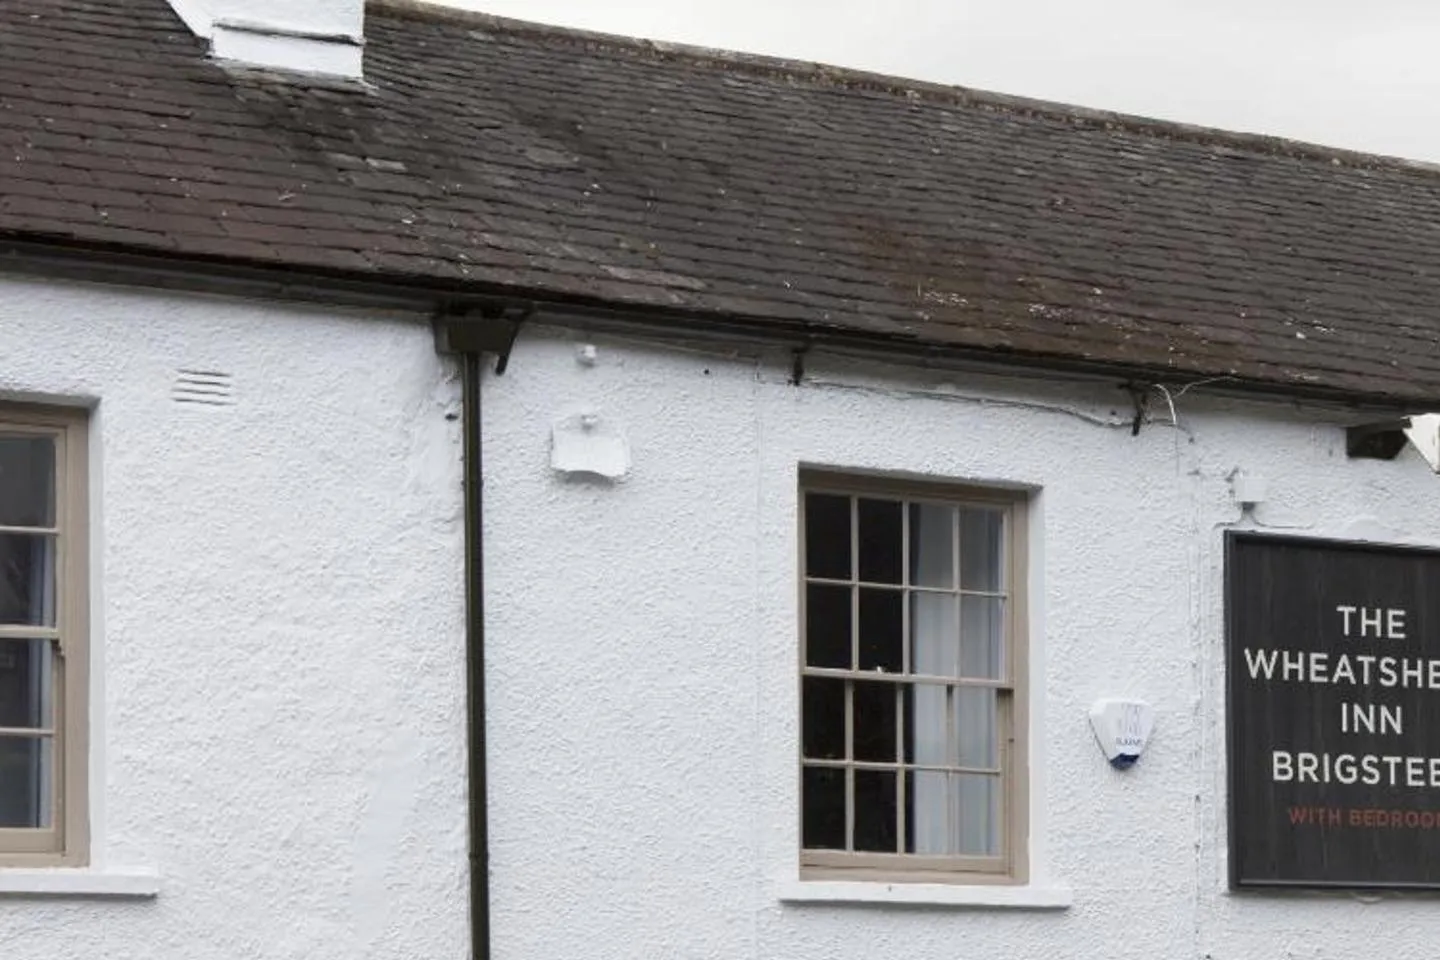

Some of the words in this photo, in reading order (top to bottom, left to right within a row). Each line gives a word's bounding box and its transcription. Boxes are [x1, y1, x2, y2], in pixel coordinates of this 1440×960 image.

[1336, 605, 1407, 639] THE
[1340, 702, 1403, 735] INN
[1289, 807, 1342, 826] WITH
